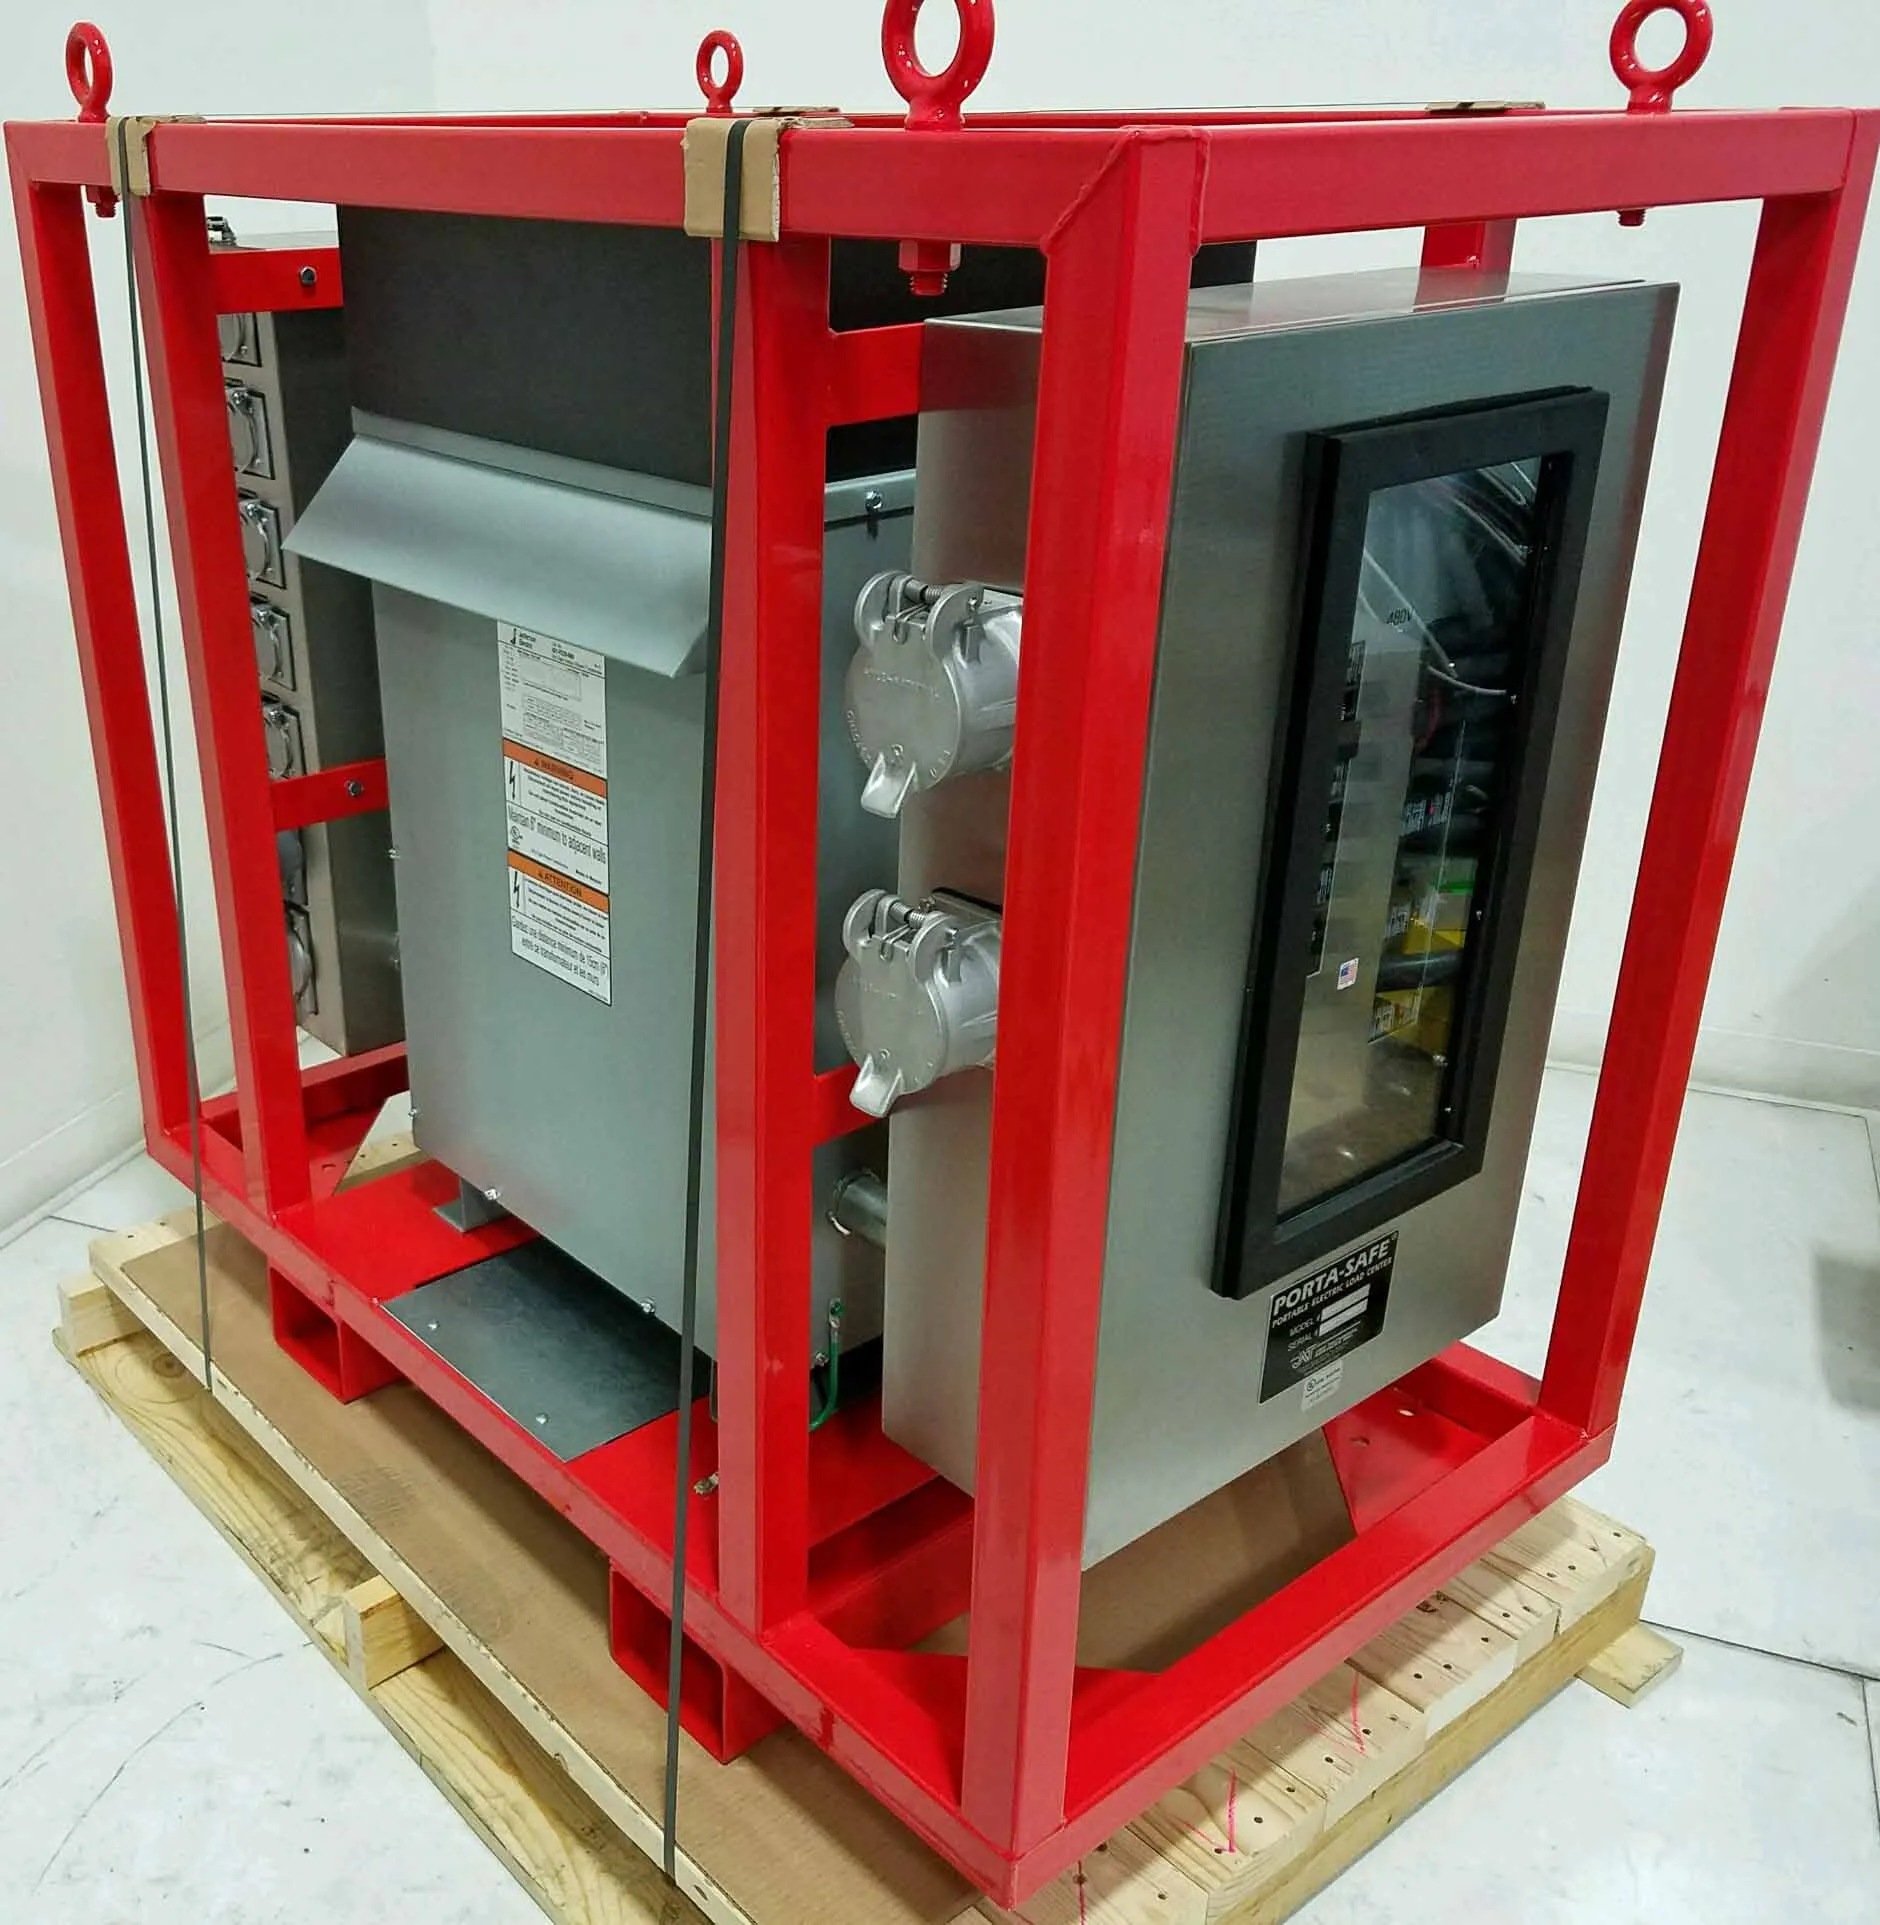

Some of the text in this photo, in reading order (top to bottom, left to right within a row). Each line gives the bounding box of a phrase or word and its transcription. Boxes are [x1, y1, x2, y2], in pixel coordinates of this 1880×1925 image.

[1385, 608, 1412, 625] 480V
[545, 872, 582, 897] ATTENTION
[1273, 1239, 1390, 1316] PORTA-SAFE
[1271, 1256, 1392, 1328] PORTABLE ELECTRIC LOAD CENTER
[1289, 1316, 1315, 1337] MODEL
[1287, 1331, 1313, 1352] SERIAL
